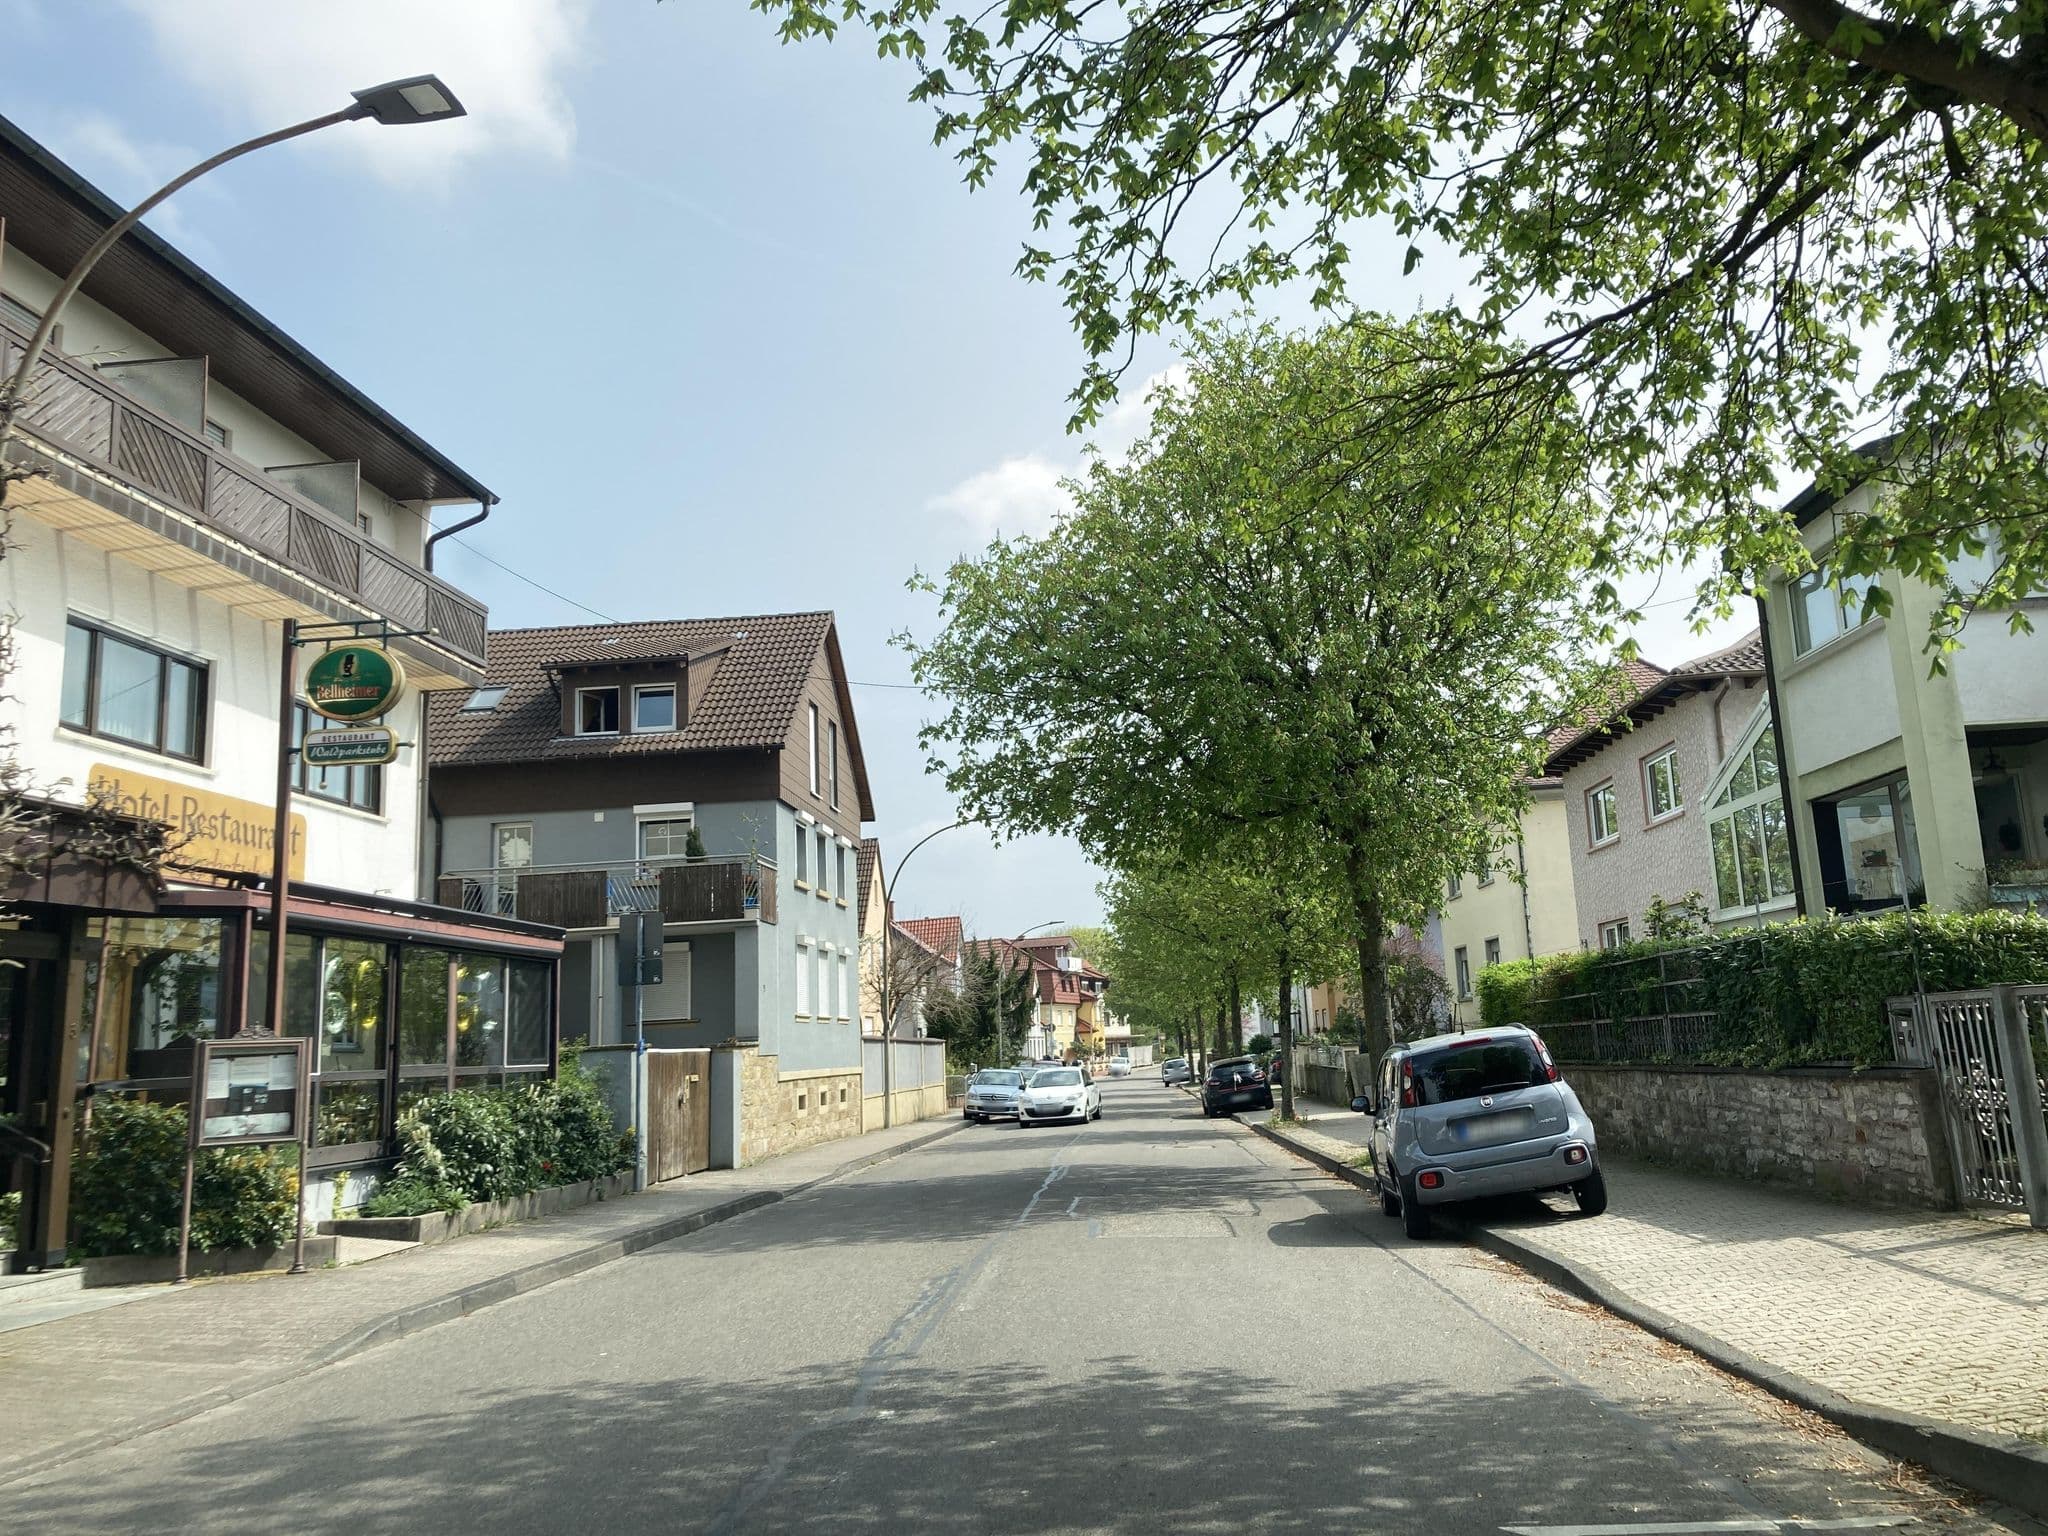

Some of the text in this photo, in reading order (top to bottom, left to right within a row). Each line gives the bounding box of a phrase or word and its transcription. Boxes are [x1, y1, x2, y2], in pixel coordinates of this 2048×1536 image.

[322, 733, 375, 742] RESTAURANT
[310, 744, 387, 758] Waldparkstube
[98, 775, 301, 856] Hotel-Restaurat
